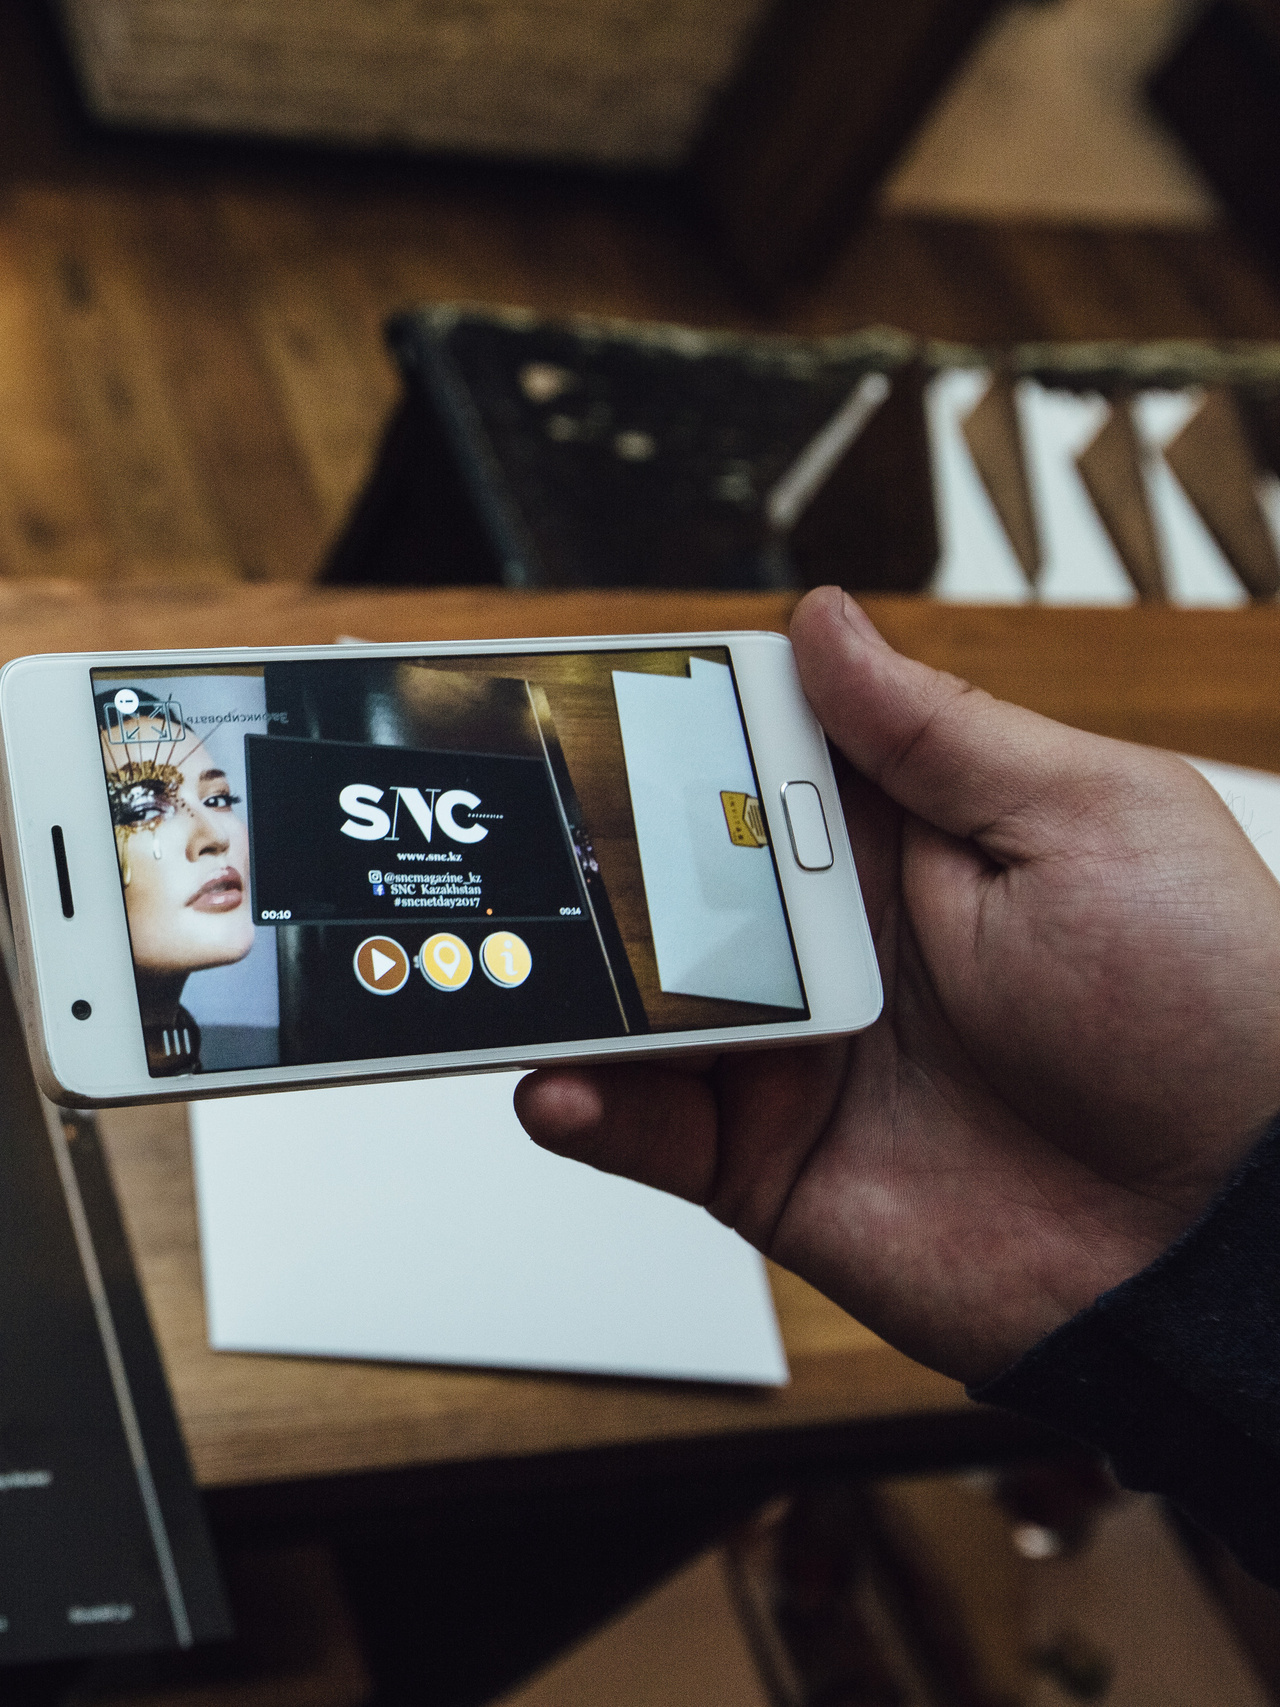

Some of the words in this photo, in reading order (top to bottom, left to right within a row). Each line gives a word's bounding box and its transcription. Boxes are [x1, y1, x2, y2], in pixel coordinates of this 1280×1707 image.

[339, 784, 489, 844] SNC
[396, 851, 463, 862] www.snc.kz
[384, 872, 482, 885] @sncmagazine_kz
[390, 883, 417, 895] SNC
[421, 883, 482, 895] Kazakhstan
[394, 895, 481, 909] #sncnetday2017
[261, 909, 292, 920] 00:10
[559, 906, 581, 916] 00:14
